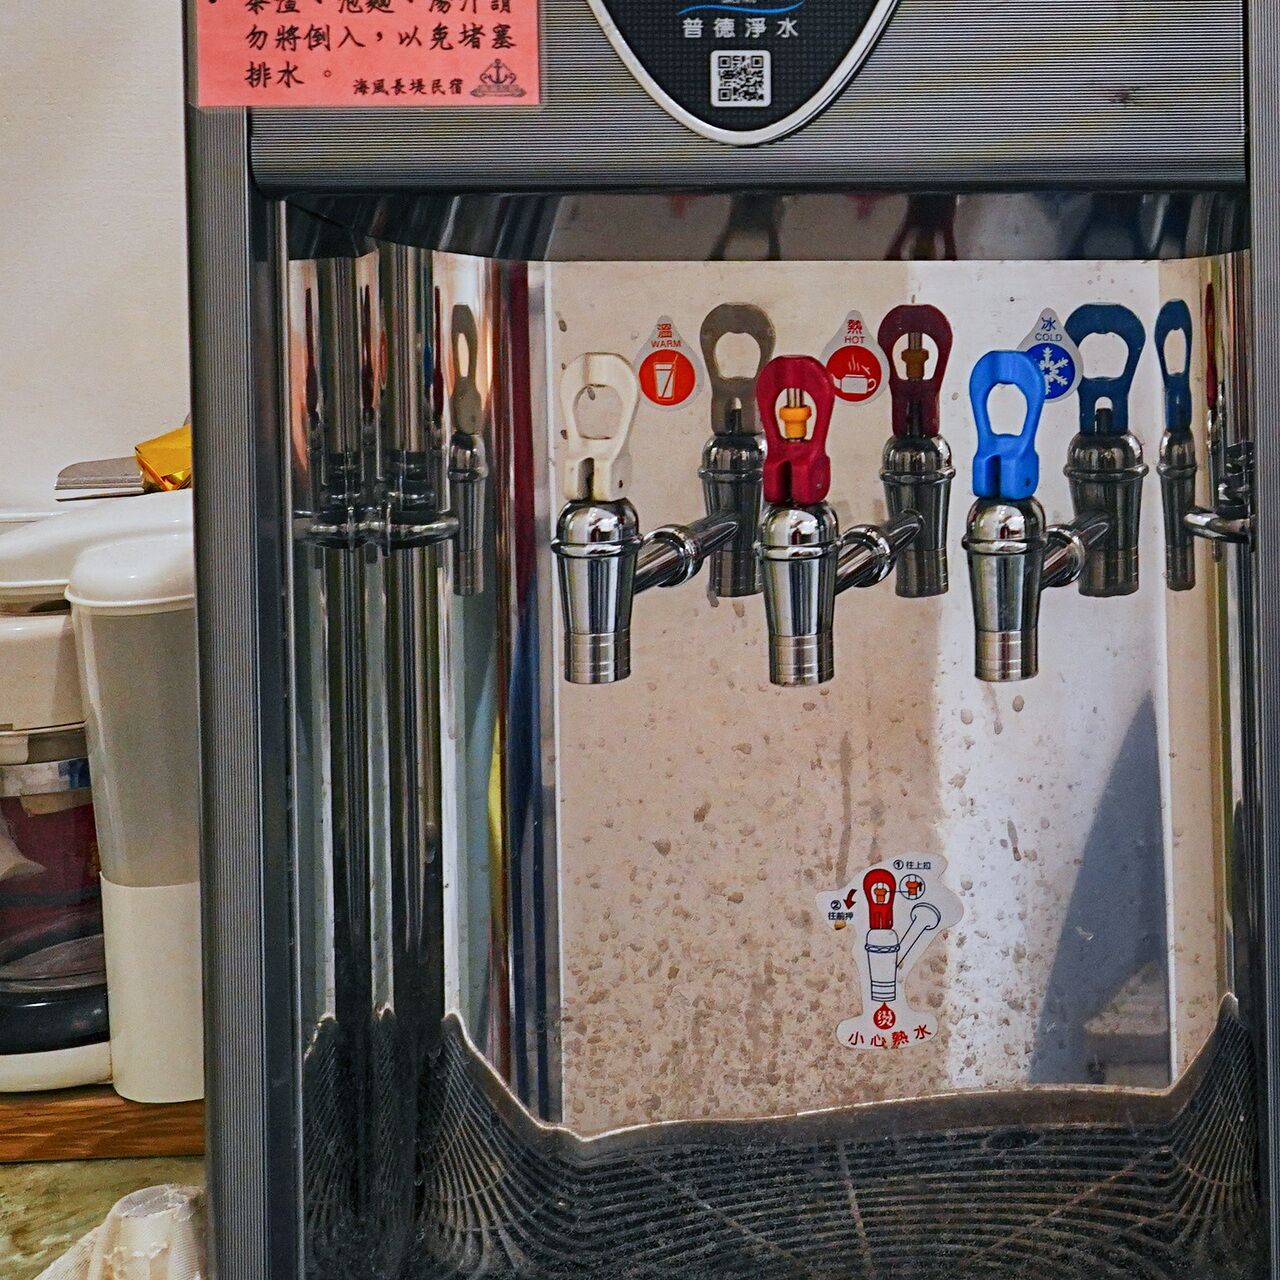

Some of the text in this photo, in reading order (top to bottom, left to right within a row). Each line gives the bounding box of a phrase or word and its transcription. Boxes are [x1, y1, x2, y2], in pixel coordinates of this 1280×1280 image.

[682, 18, 799, 38] 普德淨水
[353, 79, 464, 96] 海風長堤民宿
[657, 323, 672, 339] 溫
[846, 319, 863, 334] 熱
[1039, 315, 1056, 332] 冰
[651, 339, 681, 348] WARM
[844, 335, 865, 344] HOT
[1034, 333, 1063, 343] COLD
[878, 1011, 893, 1026] 燙
[848, 1025, 932, 1047] 小心熱水
